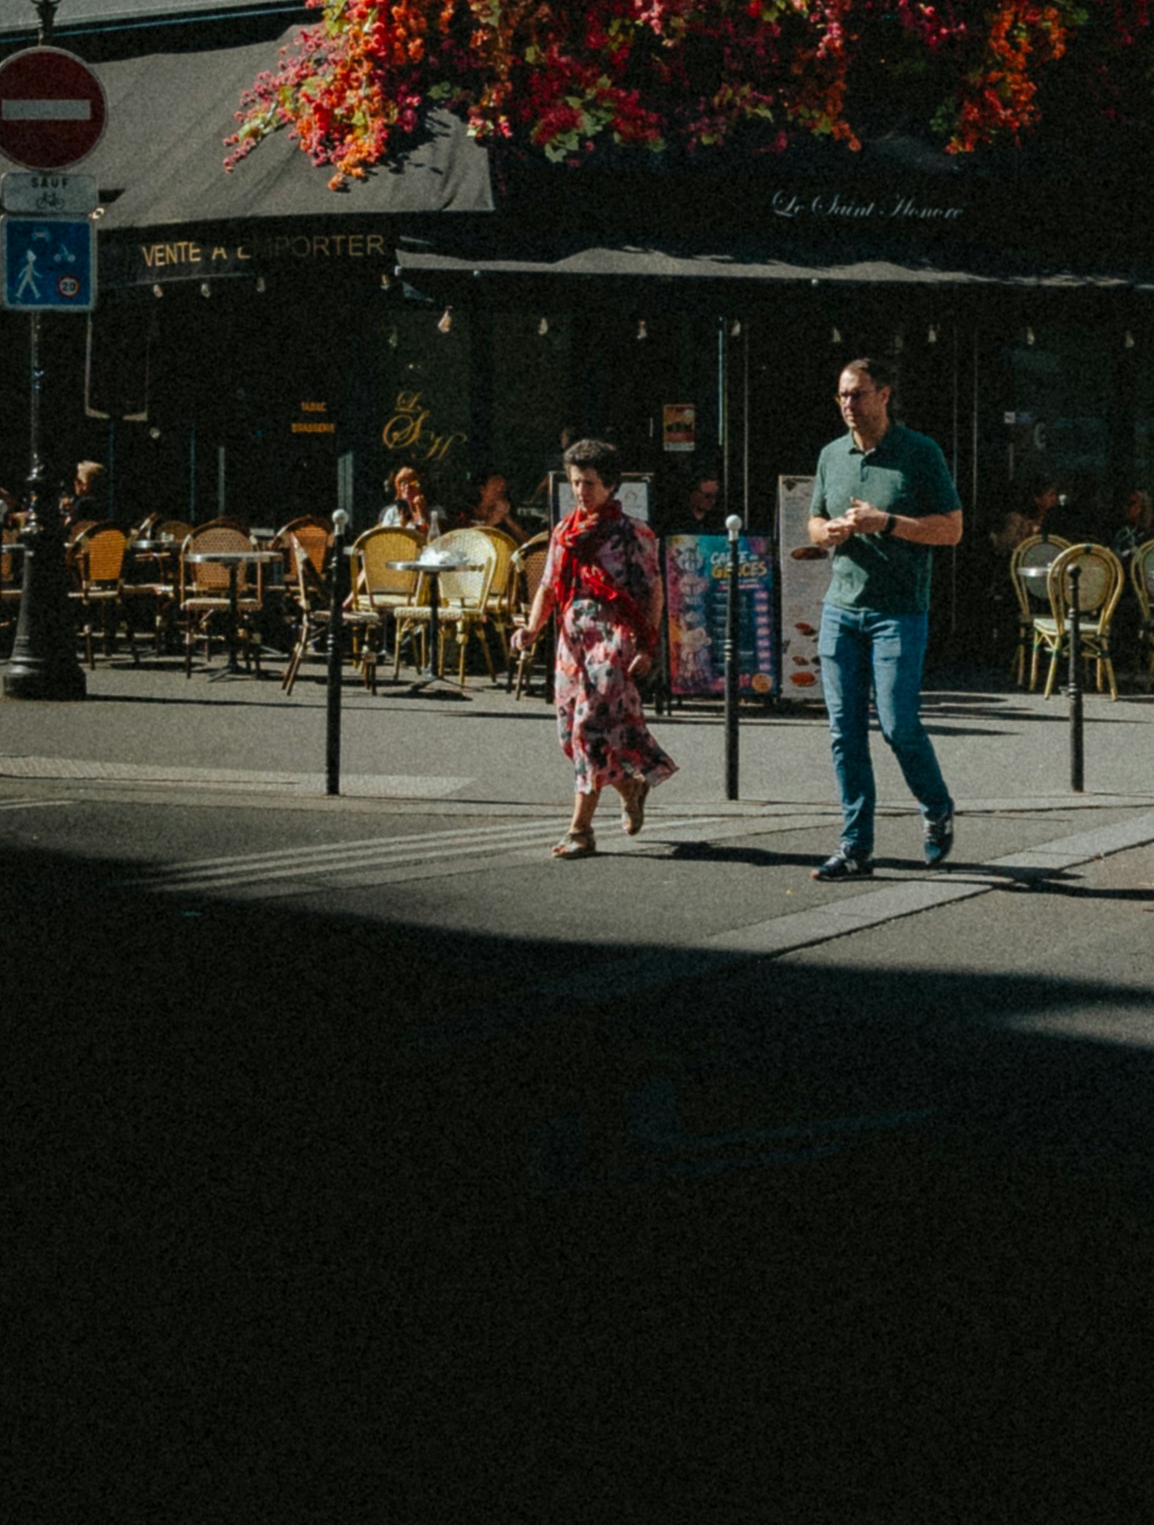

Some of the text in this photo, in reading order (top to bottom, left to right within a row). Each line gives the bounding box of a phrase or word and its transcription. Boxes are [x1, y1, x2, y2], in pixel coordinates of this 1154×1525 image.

[30, 176, 69, 189] SAUF
[771, 188, 804, 219] Le
[811, 192, 876, 219] Saint
[141, 241, 201, 267] VENTE
[62, 281, 76, 292] 20
